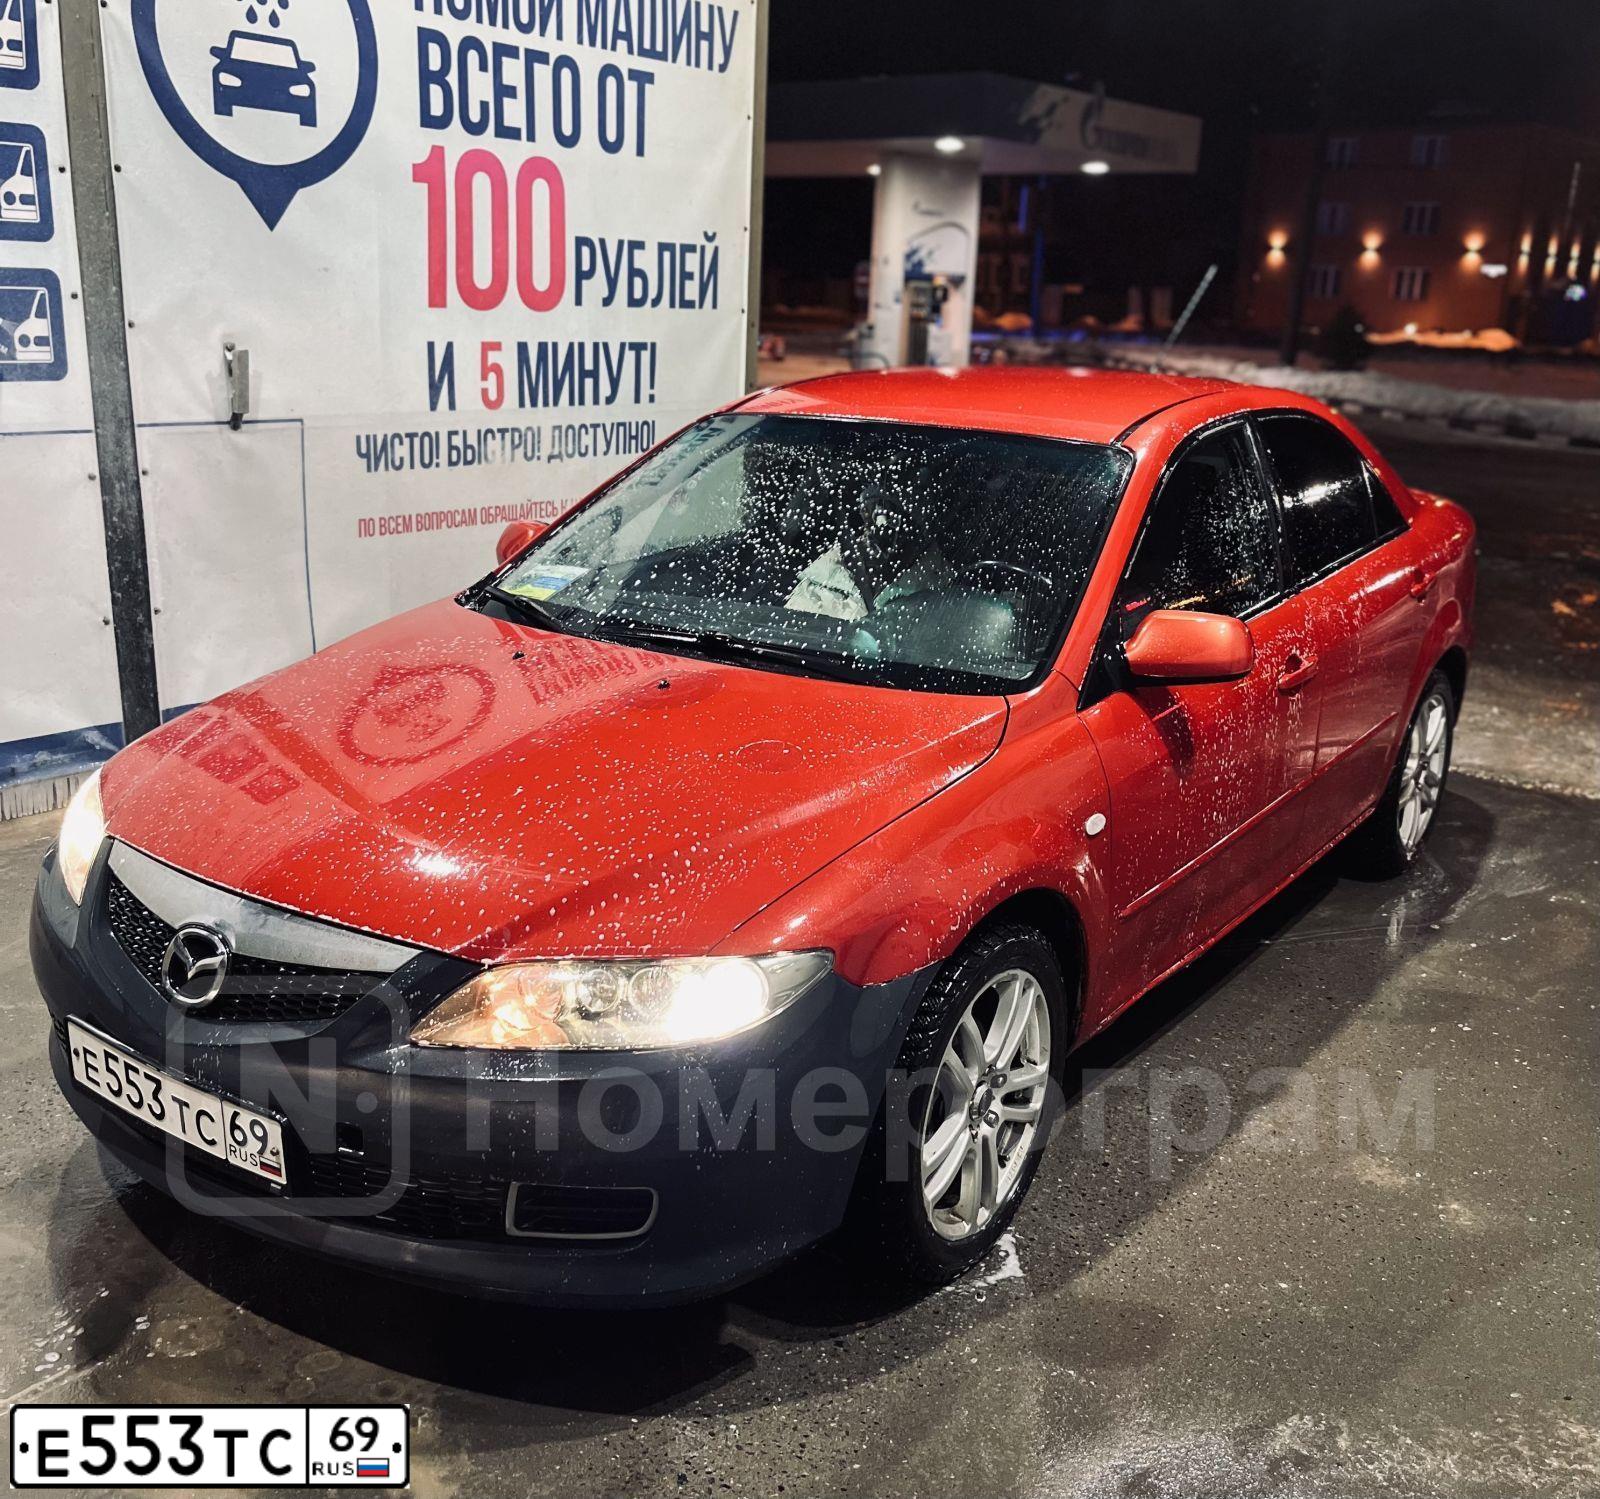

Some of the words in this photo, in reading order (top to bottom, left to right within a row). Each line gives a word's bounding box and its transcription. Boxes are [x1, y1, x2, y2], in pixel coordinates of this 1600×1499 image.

[577, 0, 739, 73] МАШИНУ
[417, 26, 581, 148] ВСЕГО
[597, 63, 655, 157] ОТ
[411, 145, 566, 312] 100
[574, 231, 719, 310] РУБЛЕЙ
[426, 341, 457, 411] И
[480, 341, 505, 410] 5
[517, 341, 656, 409] МИНУТ!
[356, 430, 440, 473] ЧИСТО!
[447, 424, 541, 467] БЫСТРО!
[547, 420, 656, 464] ДОСТУПНО!
[358, 518, 376, 538] ПО
[379, 514, 413, 536] ВСЕМ
[416, 508, 478, 532] ВОПРОСАМ
[481, 499, 559, 525] ОБРАЩАЙТЕСЬ
[229, 1110, 269, 1156] 69
[229, 1144, 259, 1168] RUS
